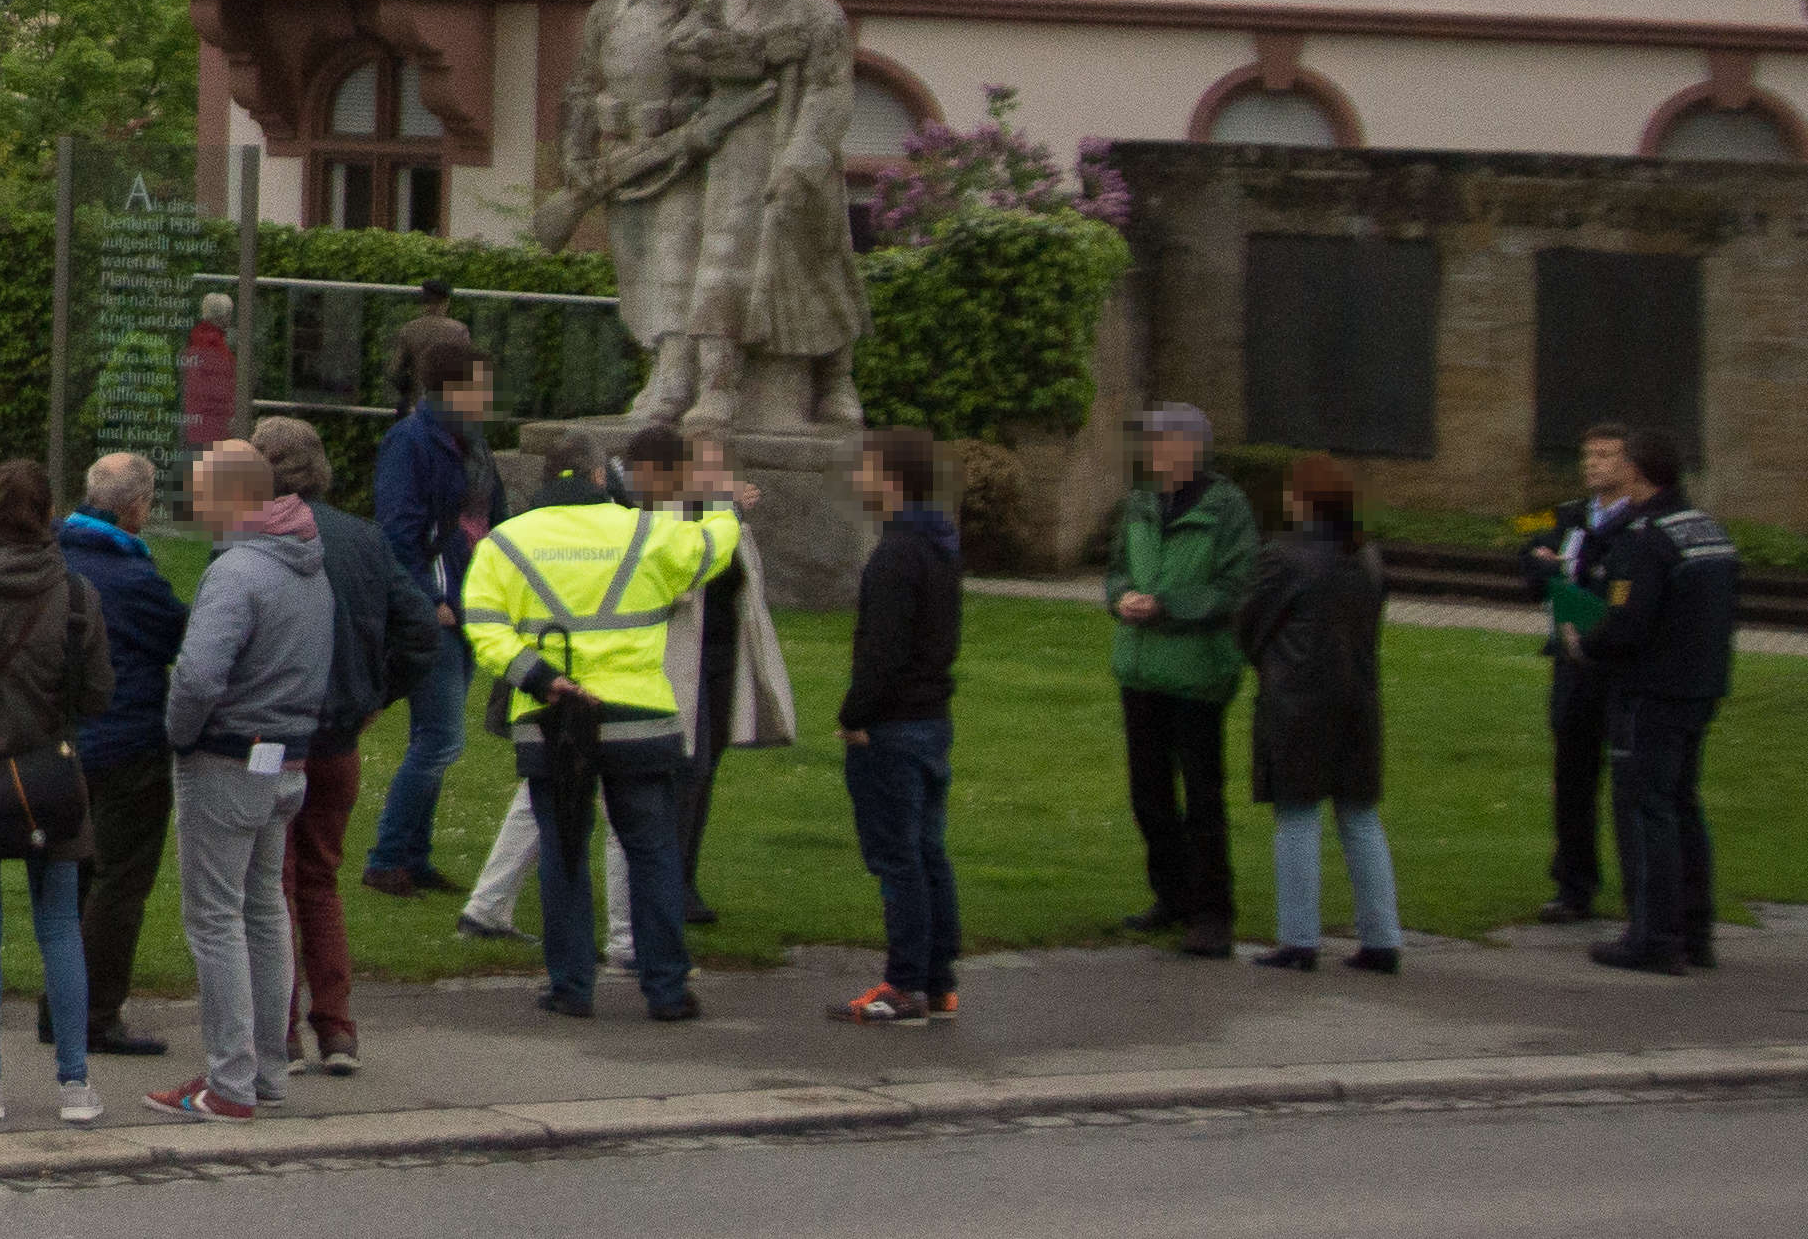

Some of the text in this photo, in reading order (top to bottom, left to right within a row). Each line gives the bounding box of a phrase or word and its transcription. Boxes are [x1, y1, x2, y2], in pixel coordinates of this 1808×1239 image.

[97, 423, 172, 442] und Kinder
[533, 546, 622, 562] ORDNUNGSAMT
